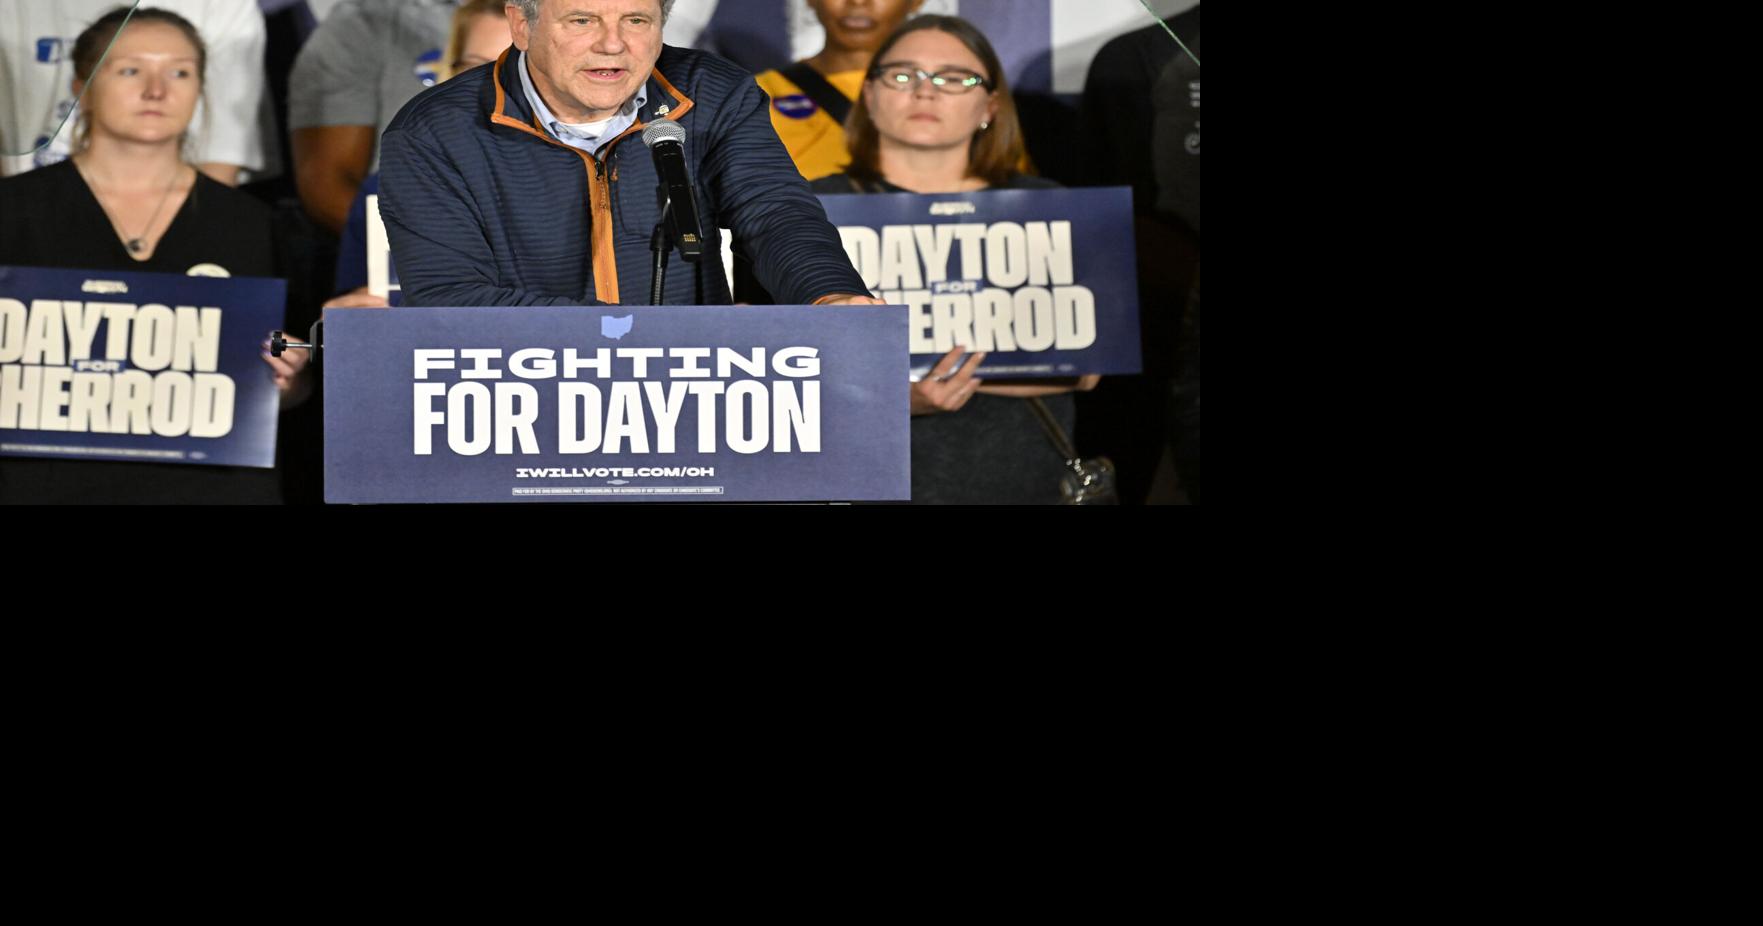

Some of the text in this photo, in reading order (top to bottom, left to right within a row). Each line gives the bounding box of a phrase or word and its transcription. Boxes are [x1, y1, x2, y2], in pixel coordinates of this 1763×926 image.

[838, 220, 1074, 288] DAYTON
[0, 298, 222, 372] DAYTON
[868, 286, 1097, 354] ERROD
[413, 346, 821, 379] FIGHTING
[0, 364, 236, 438] HERROD
[413, 379, 821, 455] FOR DAYTON
[515, 467, 715, 478] IWILLVOTE.COM/OH
